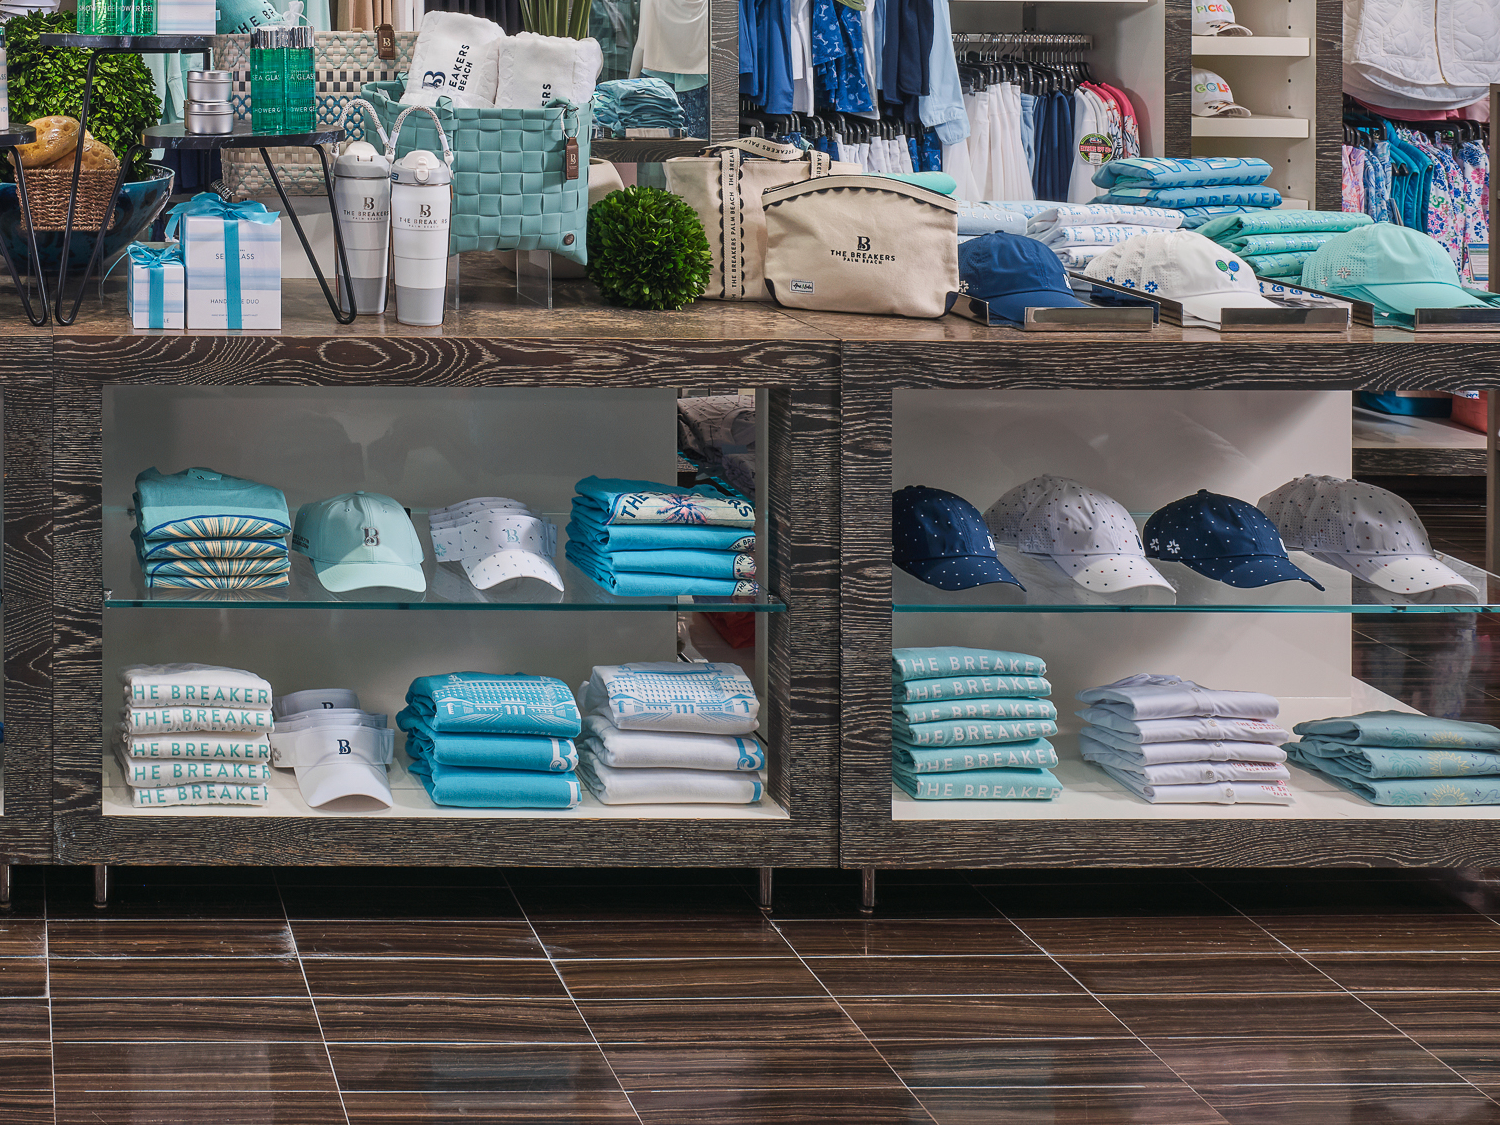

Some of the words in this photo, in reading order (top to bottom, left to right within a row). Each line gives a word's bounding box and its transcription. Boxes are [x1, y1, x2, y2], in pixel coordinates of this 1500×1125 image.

[458, 62, 473, 91] BEACH
[1194, 83, 1229, 93] GOLF
[363, 197, 374, 210] B
[420, 204, 431, 218] B
[961, 211, 1013, 222] BEACH
[857, 236, 870, 251] B
[851, 252, 896, 261] BREAKERS
[621, 491, 649, 518] THE
[362, 526, 380, 546] B
[736, 556, 746, 566] THE
[737, 581, 746, 593] THE
[897, 657, 939, 672] THE
[171, 685, 268, 703] BREAKER
[132, 710, 171, 727] THE
[952, 704, 1050, 718] BREAKER
[953, 723, 1052, 741] BREAKER
[171, 743, 269, 758] BREAKER
[337, 739, 352, 755] B
[964, 784, 1062, 799] BREAKER
